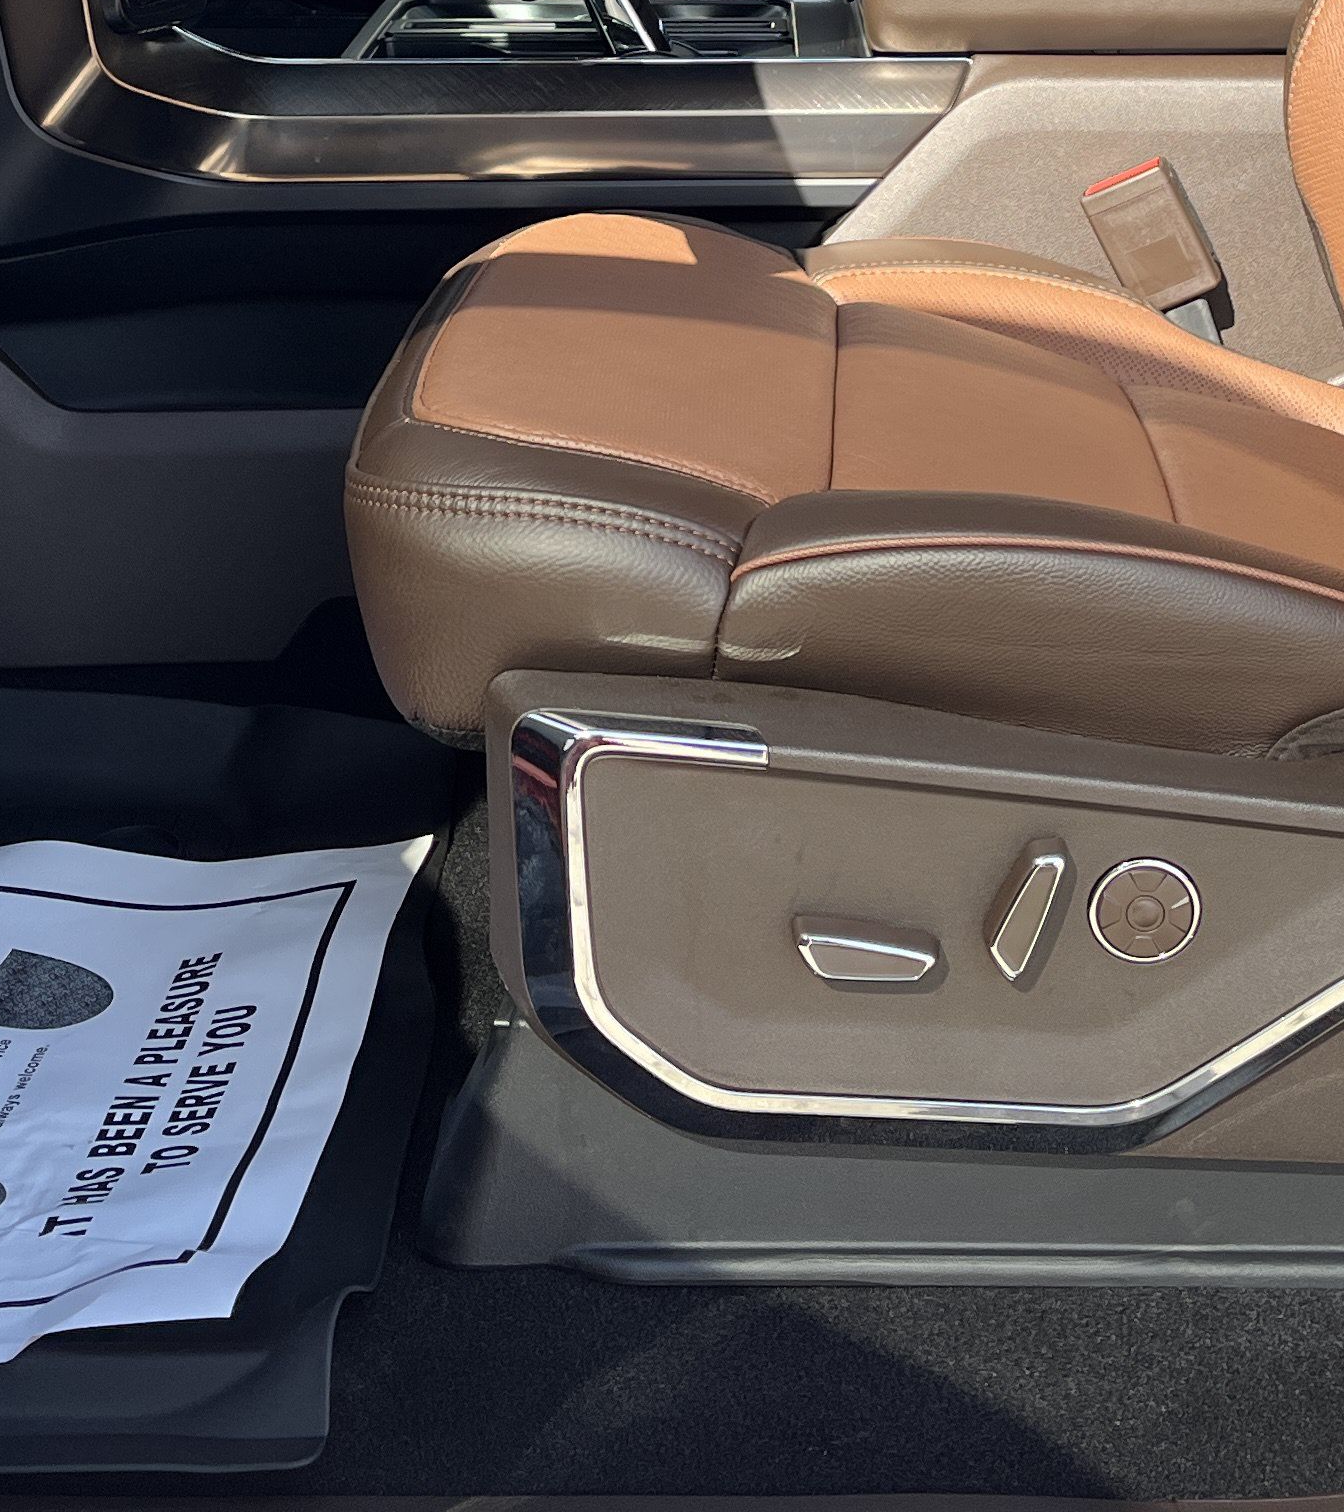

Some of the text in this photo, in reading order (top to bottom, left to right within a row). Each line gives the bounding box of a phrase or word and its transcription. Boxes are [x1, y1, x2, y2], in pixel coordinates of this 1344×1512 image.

[14, 1044, 50, 1091] welcome.
[38, 952, 224, 1237] IT HAS BEEN A PLEASURE
[140, 1005, 258, 1176] TO SERVE YOU
